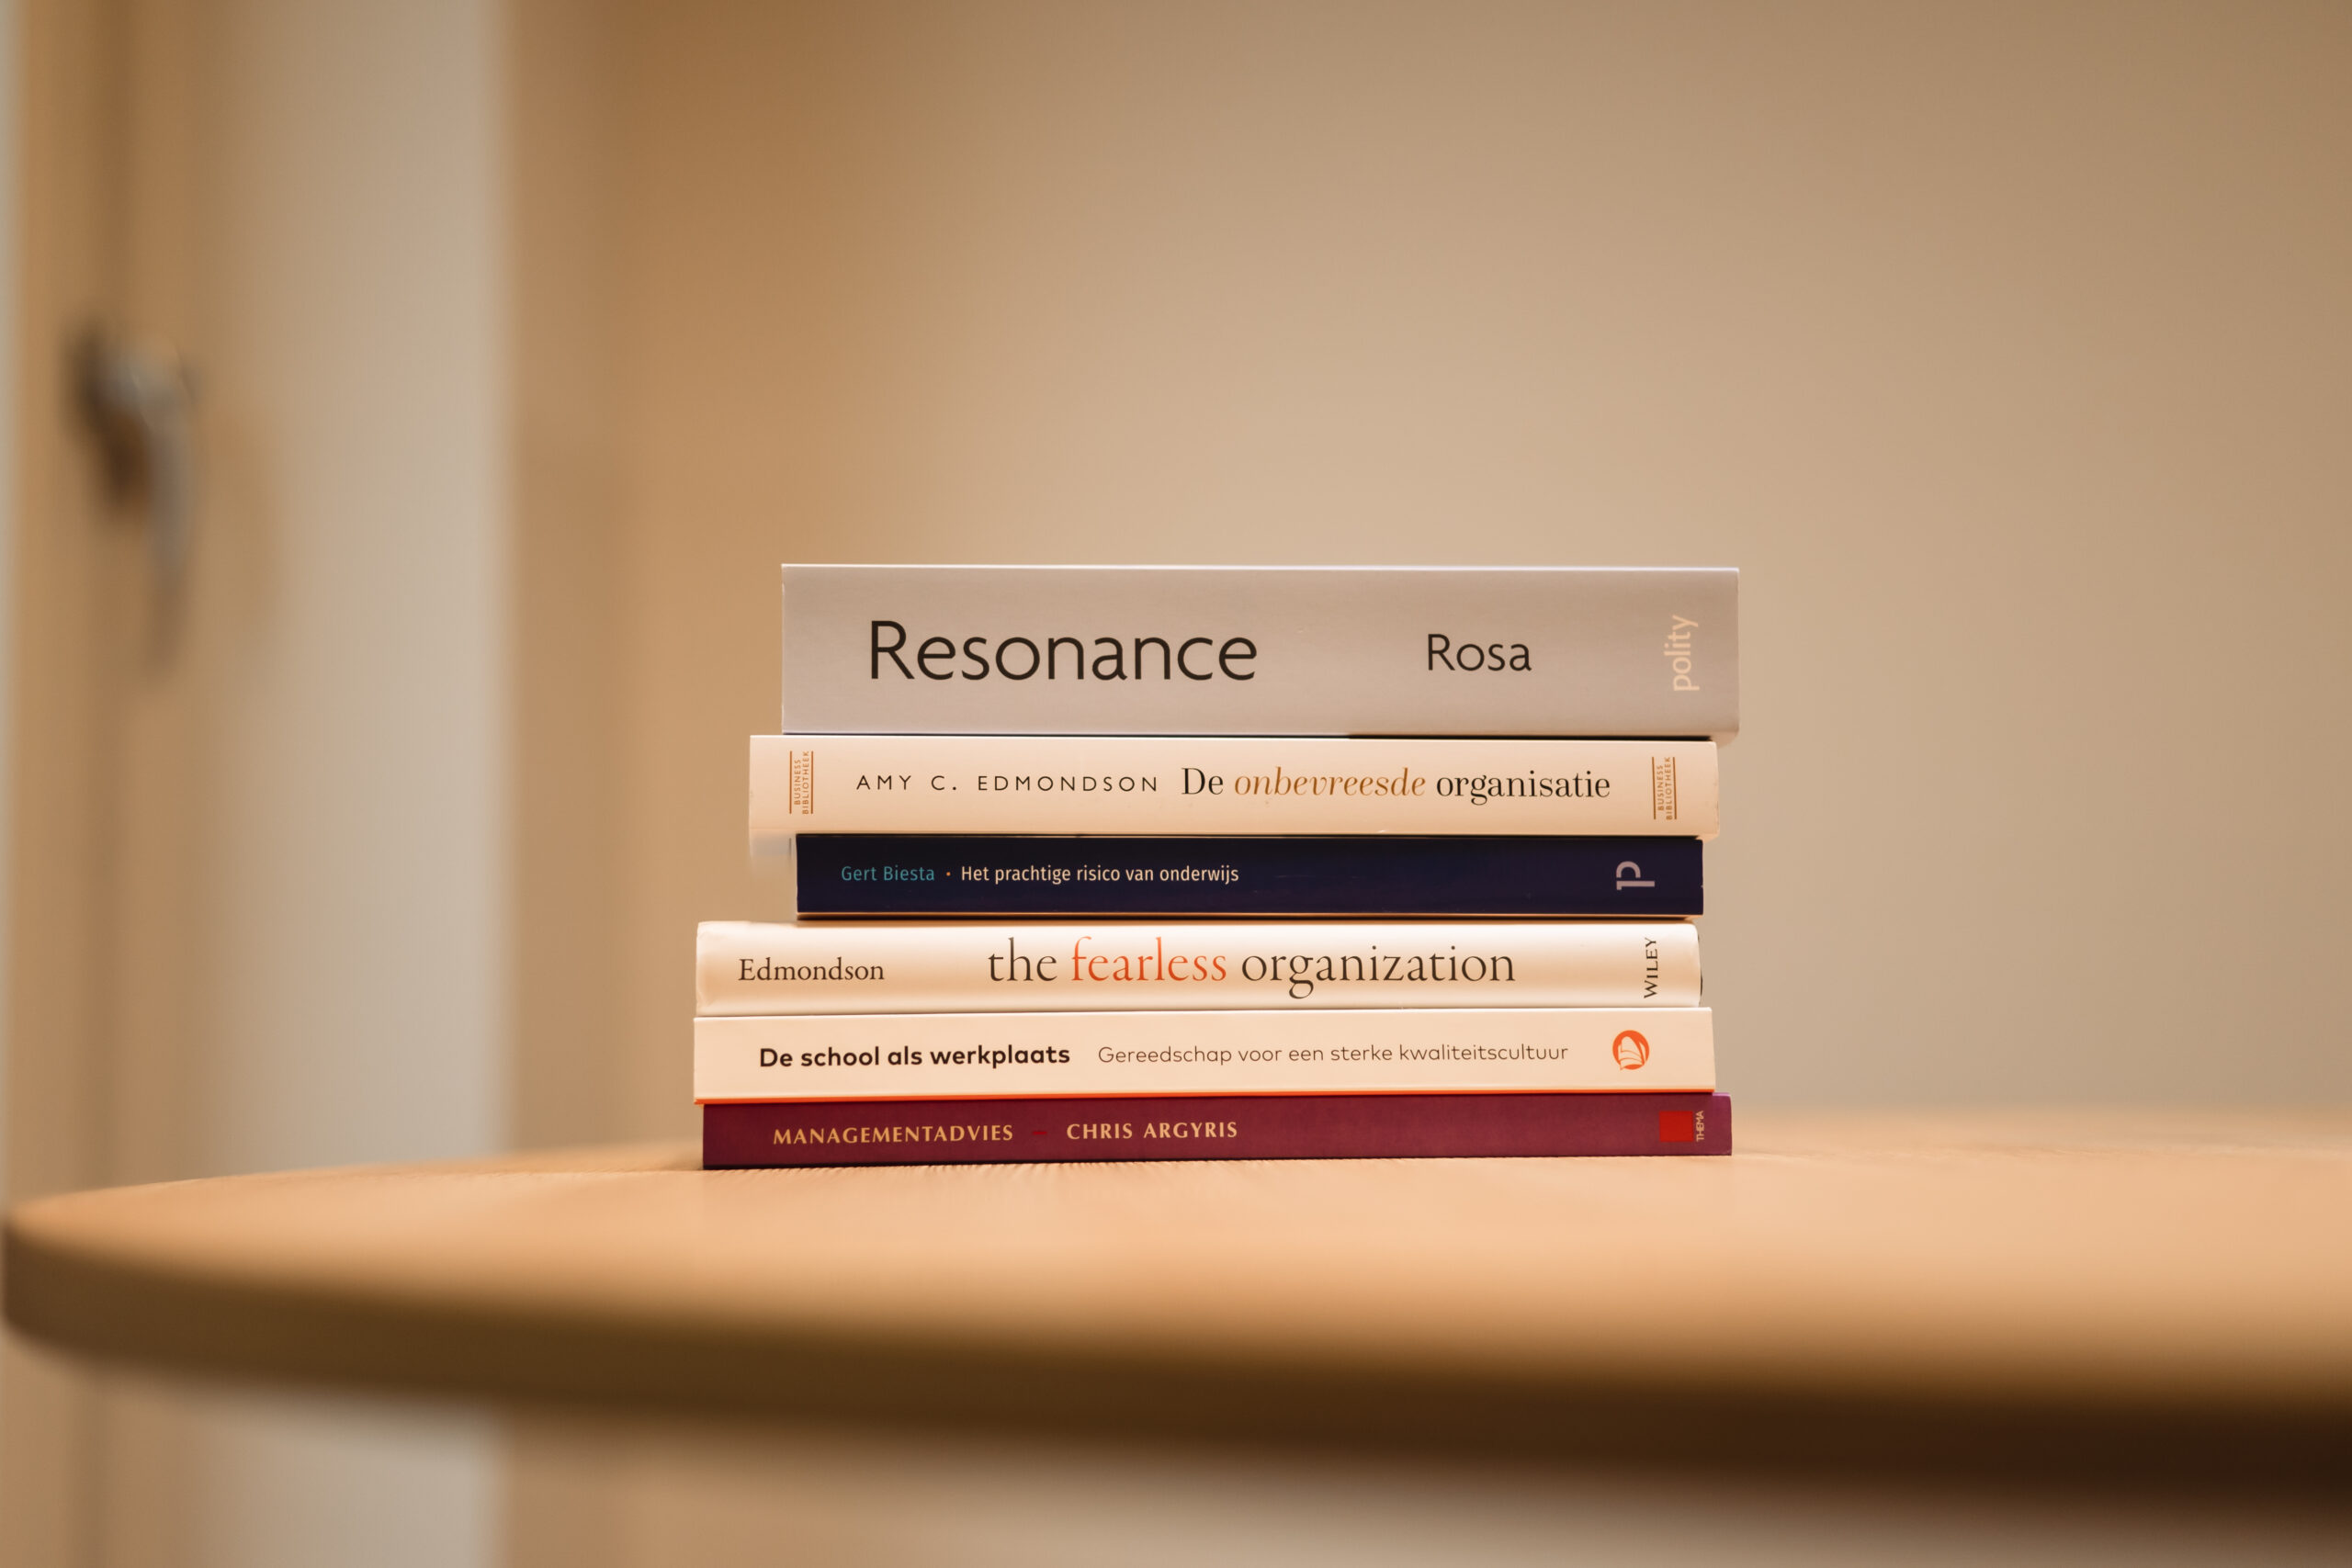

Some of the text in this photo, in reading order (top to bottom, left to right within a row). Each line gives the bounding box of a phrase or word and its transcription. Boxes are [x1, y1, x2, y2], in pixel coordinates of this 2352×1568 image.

[871, 620, 1258, 682] Resonance
[1428, 633, 1532, 671] Rosa
[1663, 614, 1700, 693] polity
[855, 774, 1157, 793] AMY C. EDMONDSON
[1182, 766, 1611, 806] De onbevreesde organisatie
[1657, 765, 1665, 811] BUSINESS
[1665, 757, 1673, 820] BIBLIOTHEEK
[841, 864, 935, 882] Gert Biesta
[961, 864, 1239, 886] Het prachtige risico van onderwijs
[738, 956, 885, 981] Edmondson
[988, 936, 1516, 999] the fearless organization
[1643, 936, 1659, 999] WILEY
[760, 1043, 1070, 1069] De school als werkplaats
[1098, 1043, 1569, 1066] Gereedschap voor een sterke kwaliteitscultuur
[773, 1124, 1013, 1145] MANAGEMENTADVIES
[1066, 1121, 1238, 1140] CHRIS ARGYRIS
[1695, 1110, 1705, 1143] THEMA
